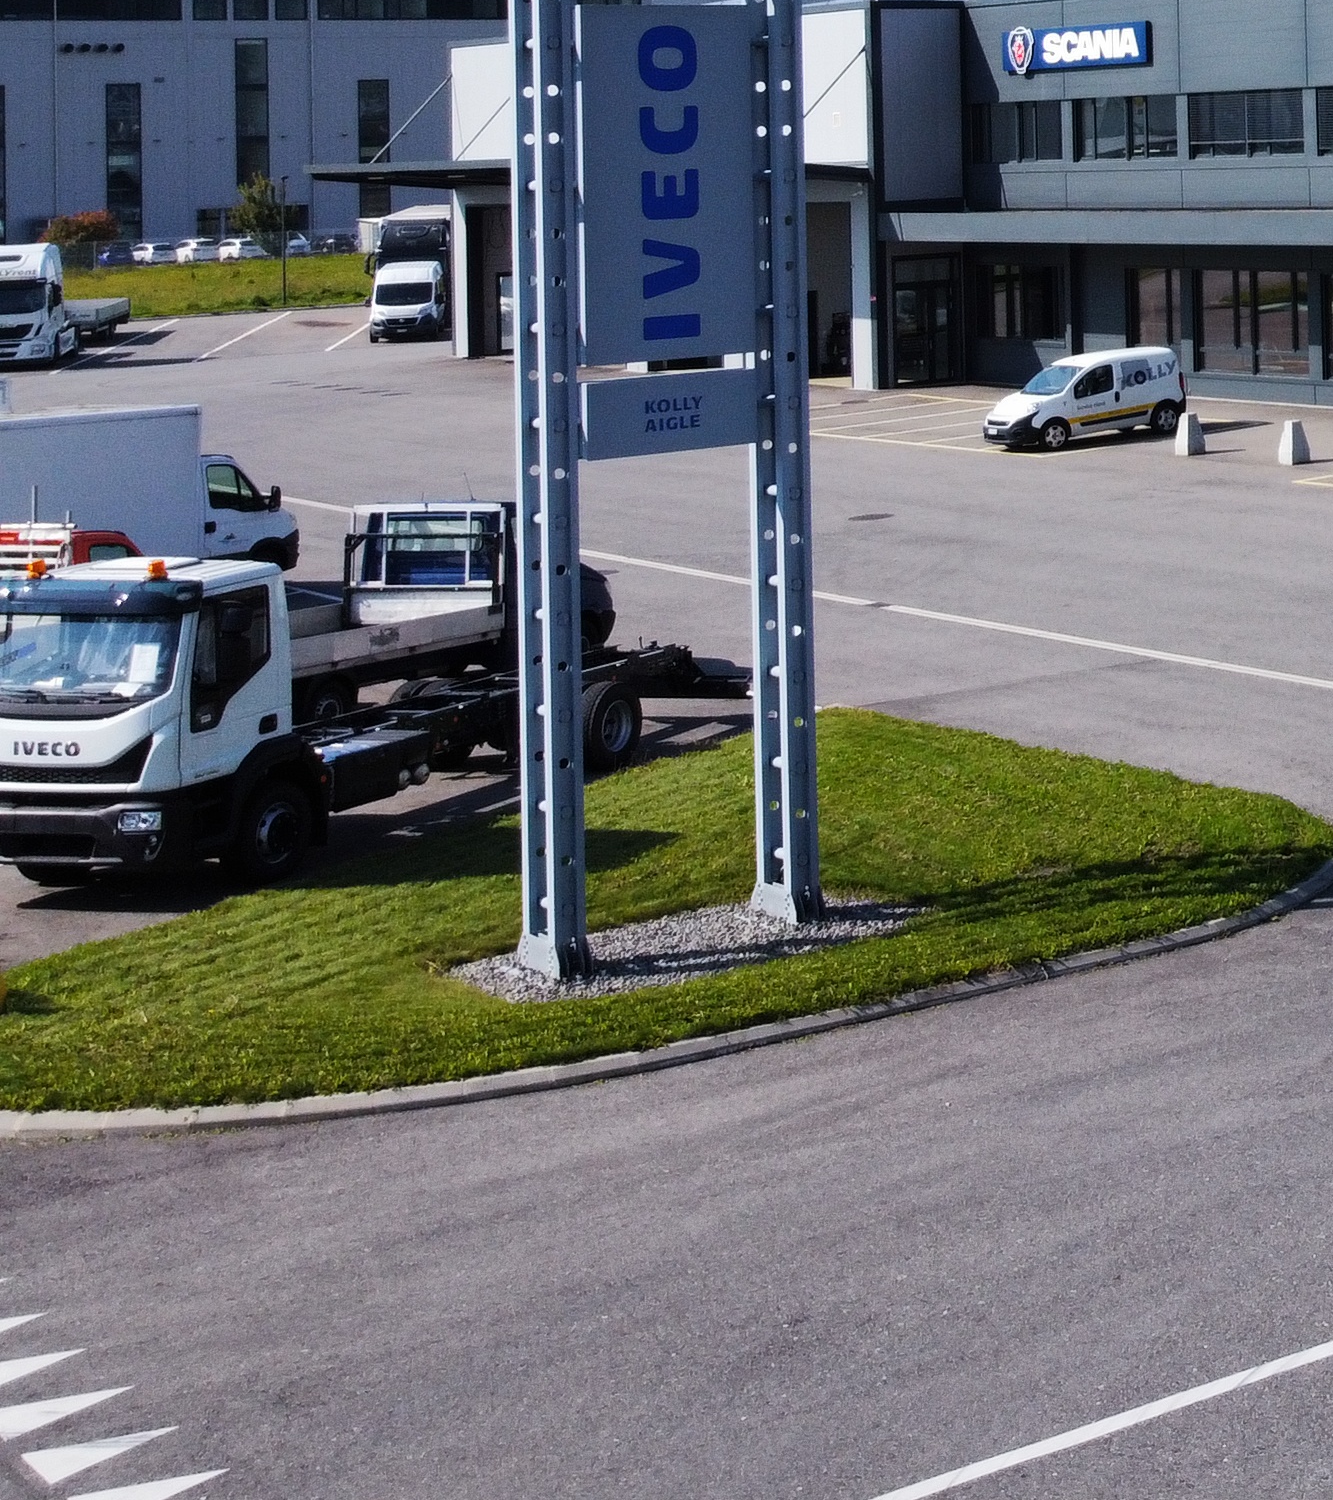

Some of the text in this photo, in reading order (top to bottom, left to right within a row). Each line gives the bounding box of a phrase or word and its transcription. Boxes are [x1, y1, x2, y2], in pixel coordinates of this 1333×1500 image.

[1042, 27, 1140, 64] SCANIA
[637, 24, 701, 341] IVECO
[1120, 360, 1177, 390] KOLLY
[645, 395, 703, 414] KOLLY
[645, 414, 701, 433] AIGLE
[13, 741, 81, 757] IVECO
